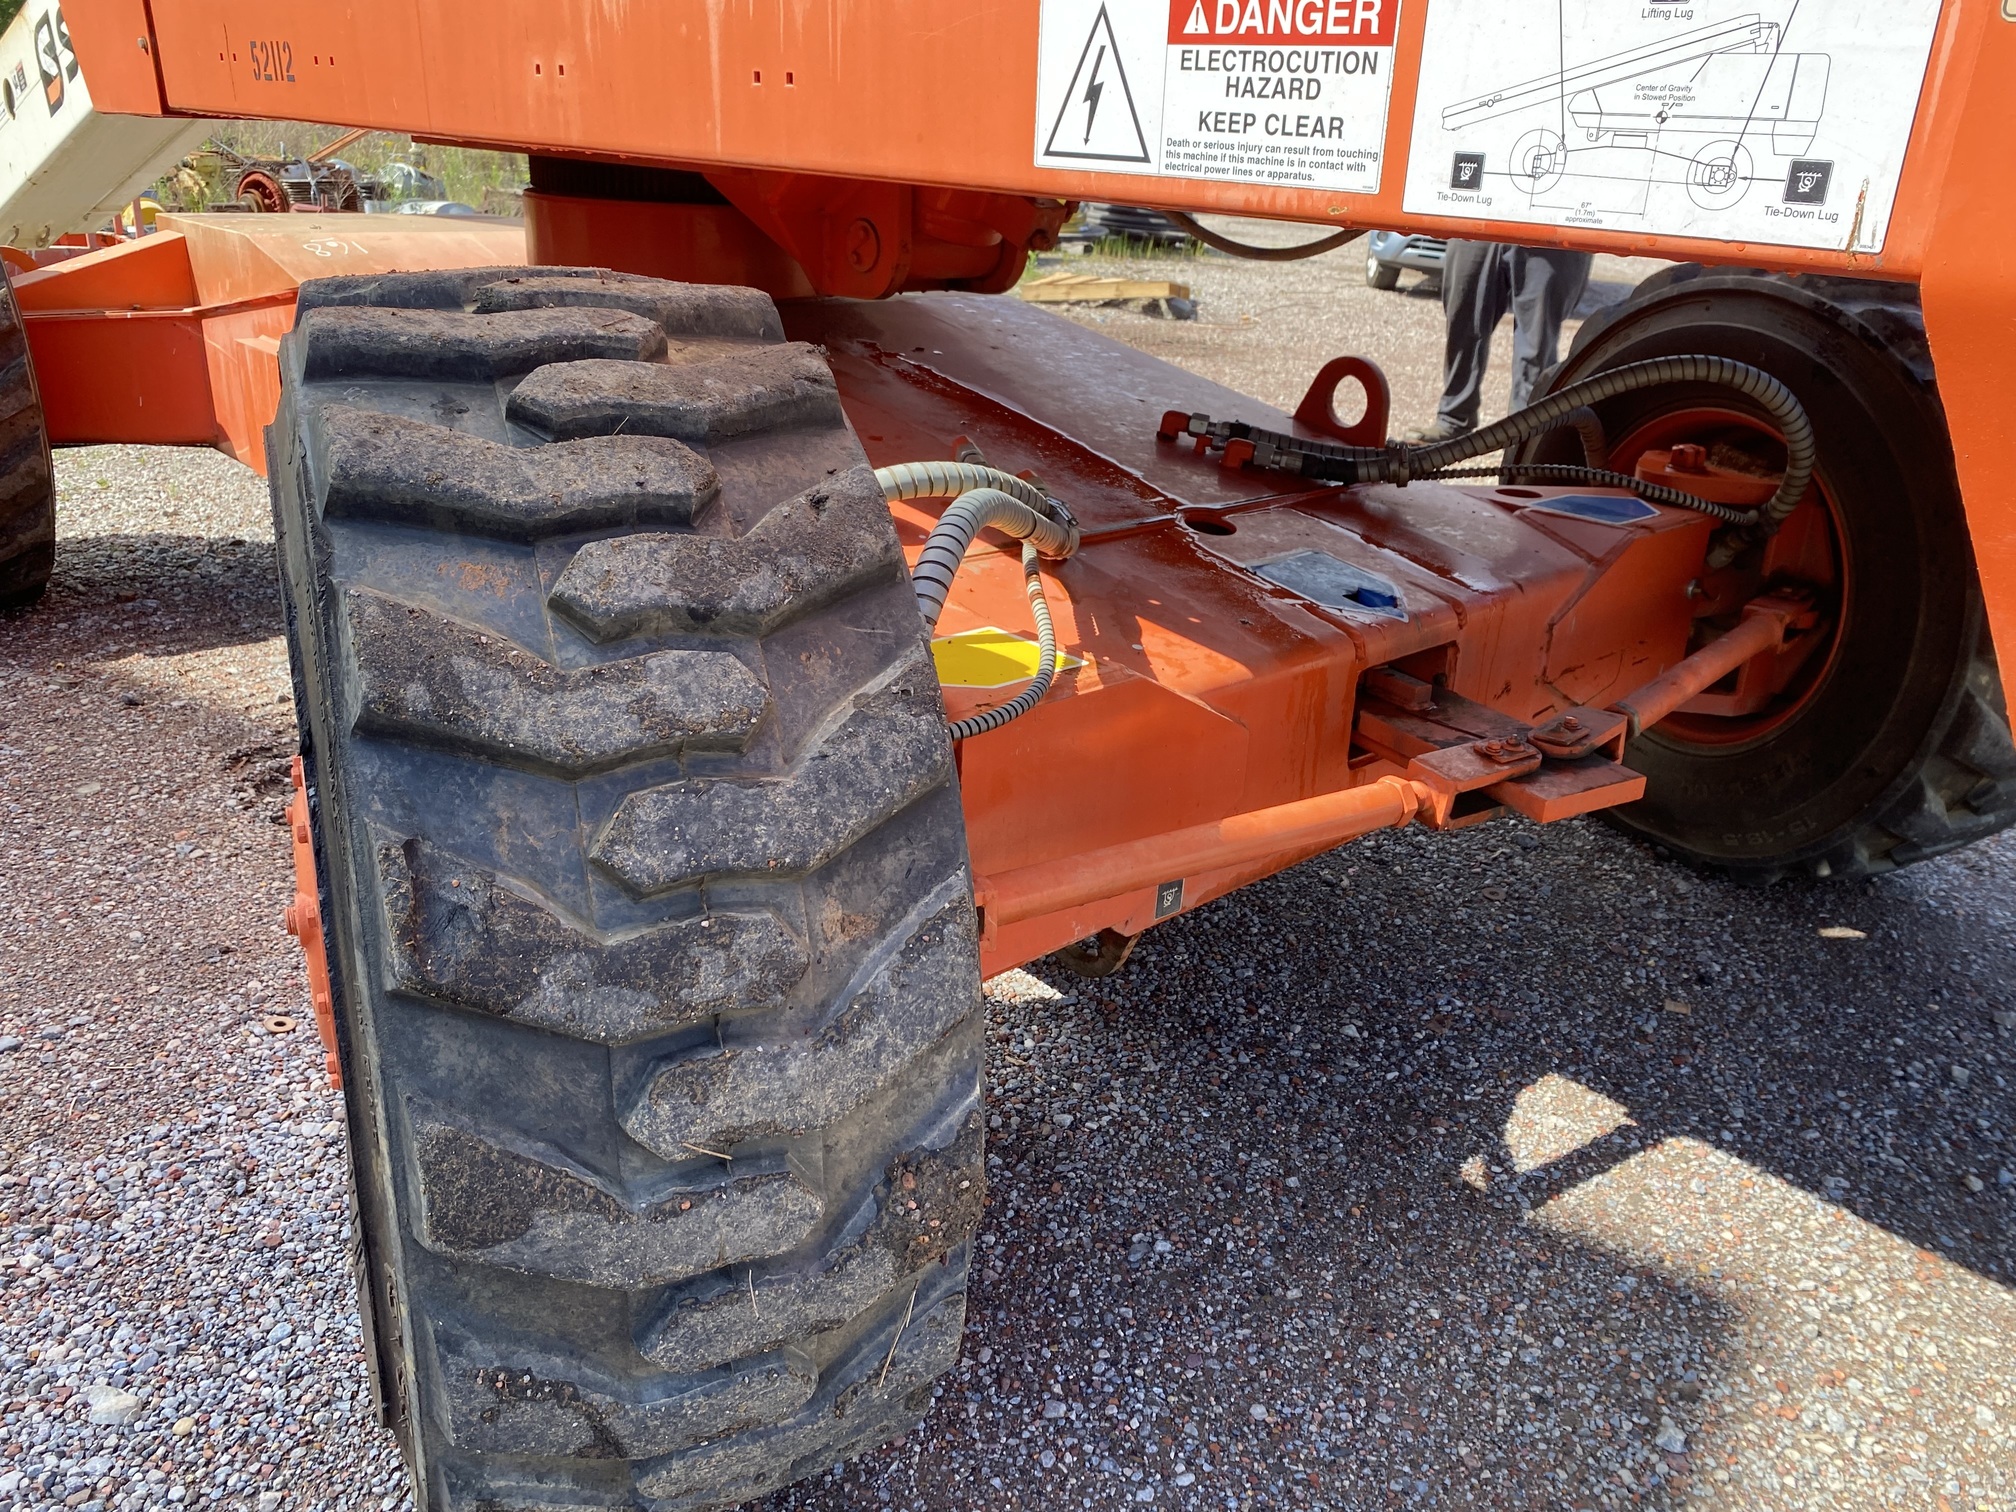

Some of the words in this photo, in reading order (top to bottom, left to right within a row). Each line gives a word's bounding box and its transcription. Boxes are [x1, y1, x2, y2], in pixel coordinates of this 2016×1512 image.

[1215, 0, 1382, 36] DANGER
[1641, 8, 1671, 21] Lifting
[1674, 8, 1694, 21] Lug
[249, 40, 296, 83] 52112
[1180, 49, 1379, 75] ELECTROCUTION
[1225, 76, 1322, 101] HAZARD
[1635, 84, 1658, 92] Center
[1659, 84, 1667, 92] of
[1668, 84, 1693, 94] Gravity
[1641, 93, 1667, 101] Stowed
[1668, 93, 1696, 102] Position
[1198, 110, 1257, 134] KEEP
[1264, 113, 1344, 140] CLEAR
[1166, 137, 1190, 148] Death
[1192, 141, 1201, 149] or
[1203, 140, 1235, 151] serious
[1237, 141, 1263, 154] injury
[1265, 145, 1281, 154] can
[1283, 145, 1310, 156] result
[1313, 146, 1334, 157] from
[1336, 148, 1379, 162] touching
[1166, 149, 1181, 159] this
[1183, 151, 1218, 162] machine
[1220, 152, 1226, 162] if
[1228, 153, 1245, 164] this
[1246, 155, 1285, 167] machine
[1287, 157, 1295, 167] is
[1298, 158, 1306, 168] in
[1309, 160, 1344, 171] contact
[1346, 161, 1366, 172] with
[1164, 161, 1202, 173] electrical
[1204, 166, 1230, 175] power
[1232, 166, 1253, 177] lines
[1255, 169, 1265, 178] or
[1267, 170, 1315, 182] apparatus.
[1436, 192, 1475, 204] Tie-Down
[1476, 194, 1493, 206] Lug
[1565, 214, 1603, 225] approximate
[1574, 208, 1596, 217] (1.7m)
[1764, 205, 1815, 220] Tie-Down
[1817, 209, 1839, 223] Lug
